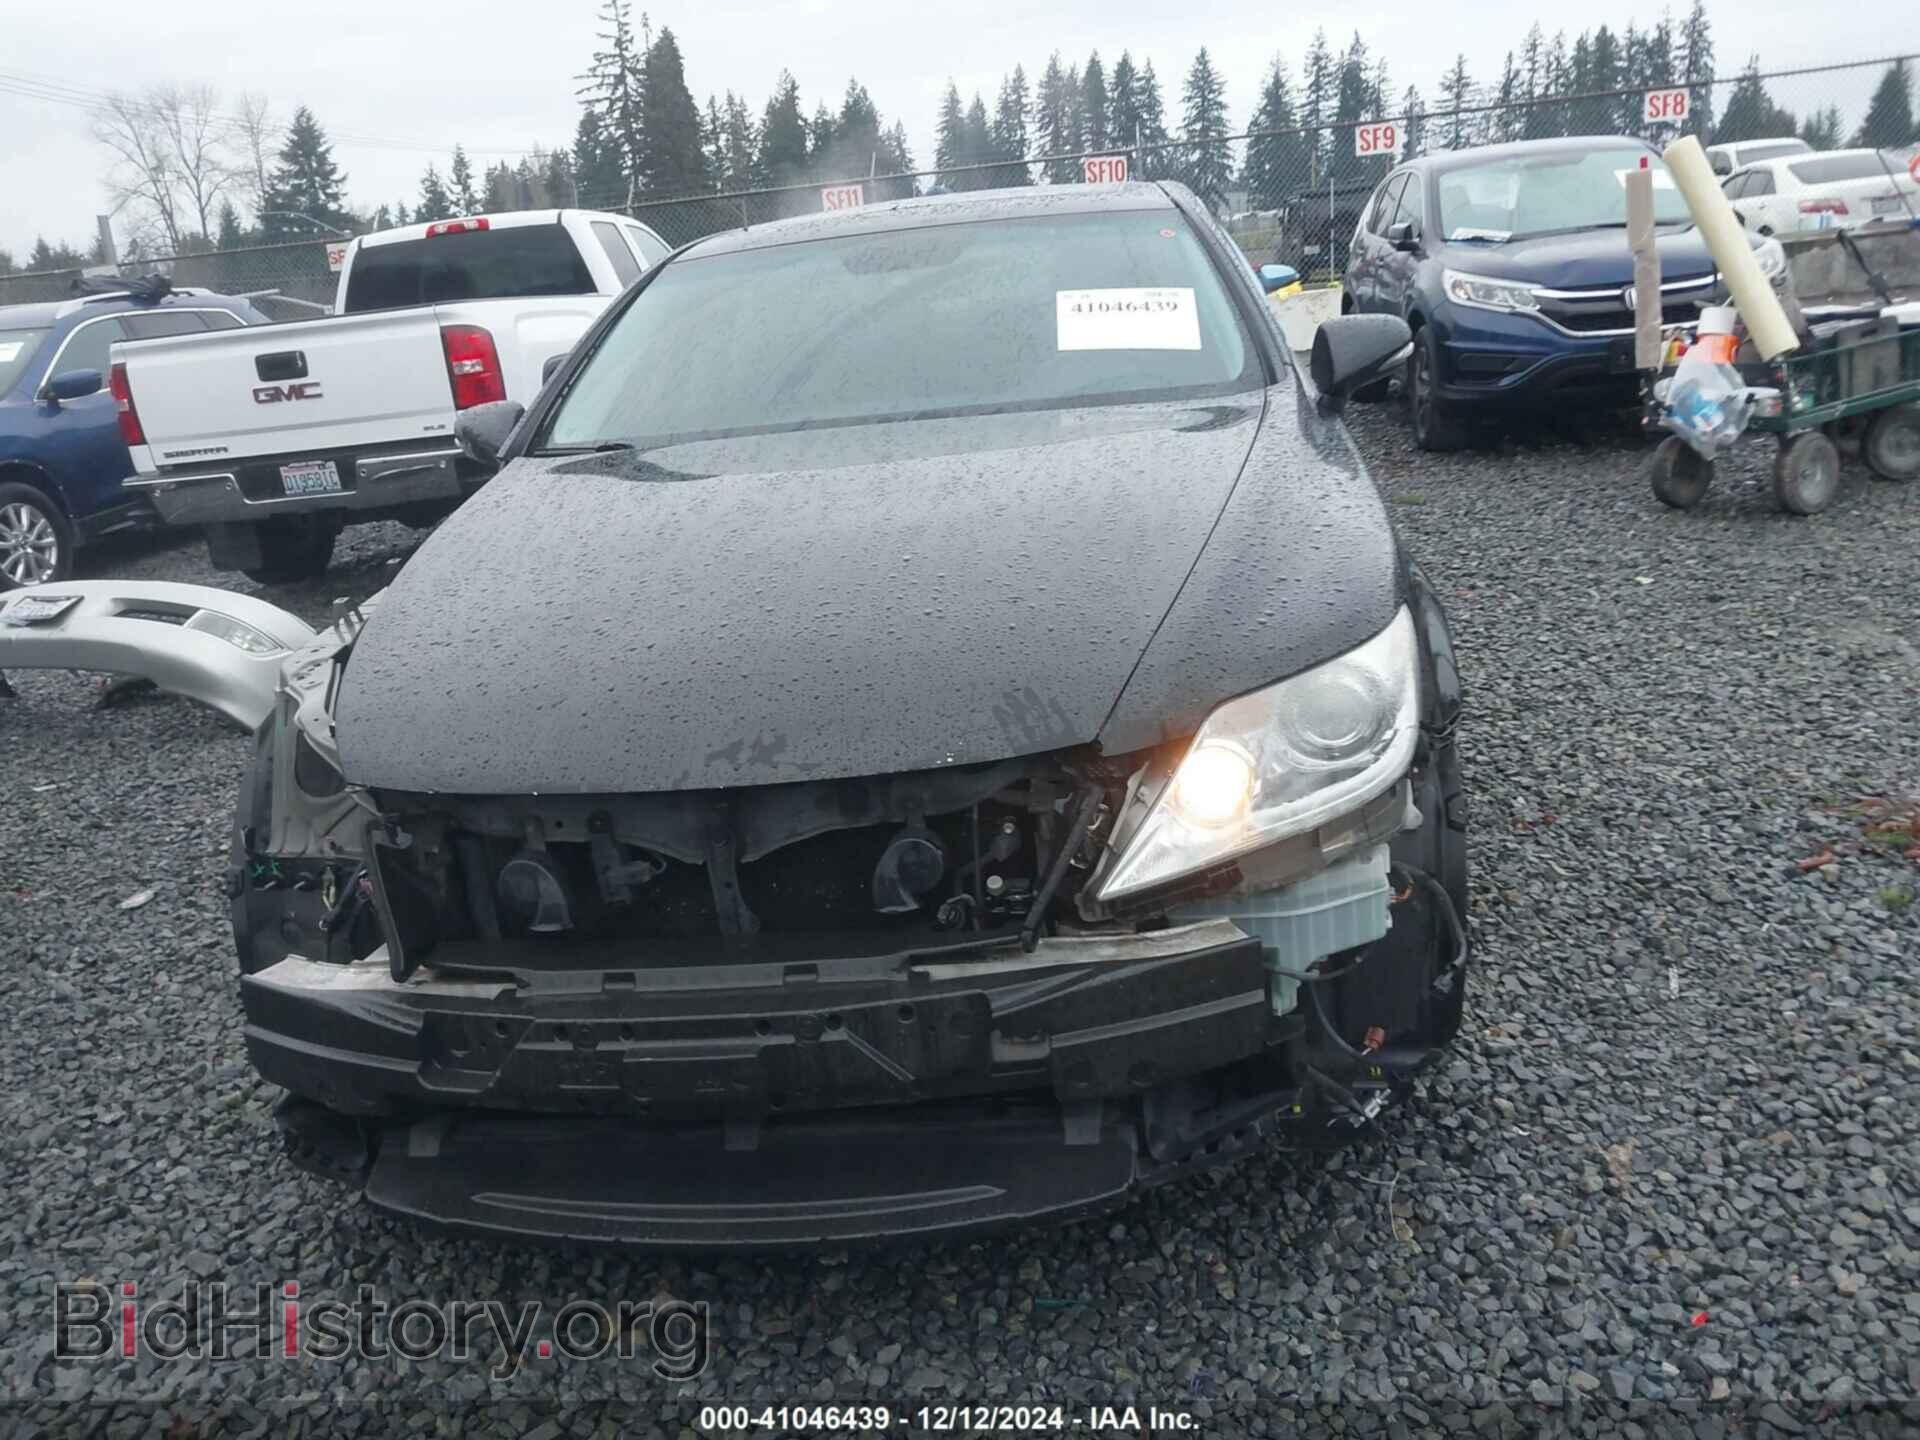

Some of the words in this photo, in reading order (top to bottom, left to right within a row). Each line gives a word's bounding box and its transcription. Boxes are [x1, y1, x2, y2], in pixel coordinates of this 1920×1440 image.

[1648, 93, 1685, 118] SF8
[1359, 126, 1396, 151] SF9
[1087, 160, 1125, 183] SF10
[826, 189, 858, 210] SF11
[328, 249, 346, 265] SF
[1071, 301, 1179, 313] 41046439
[252, 381, 323, 405] GMC
[163, 446, 228, 459] SIERRA
